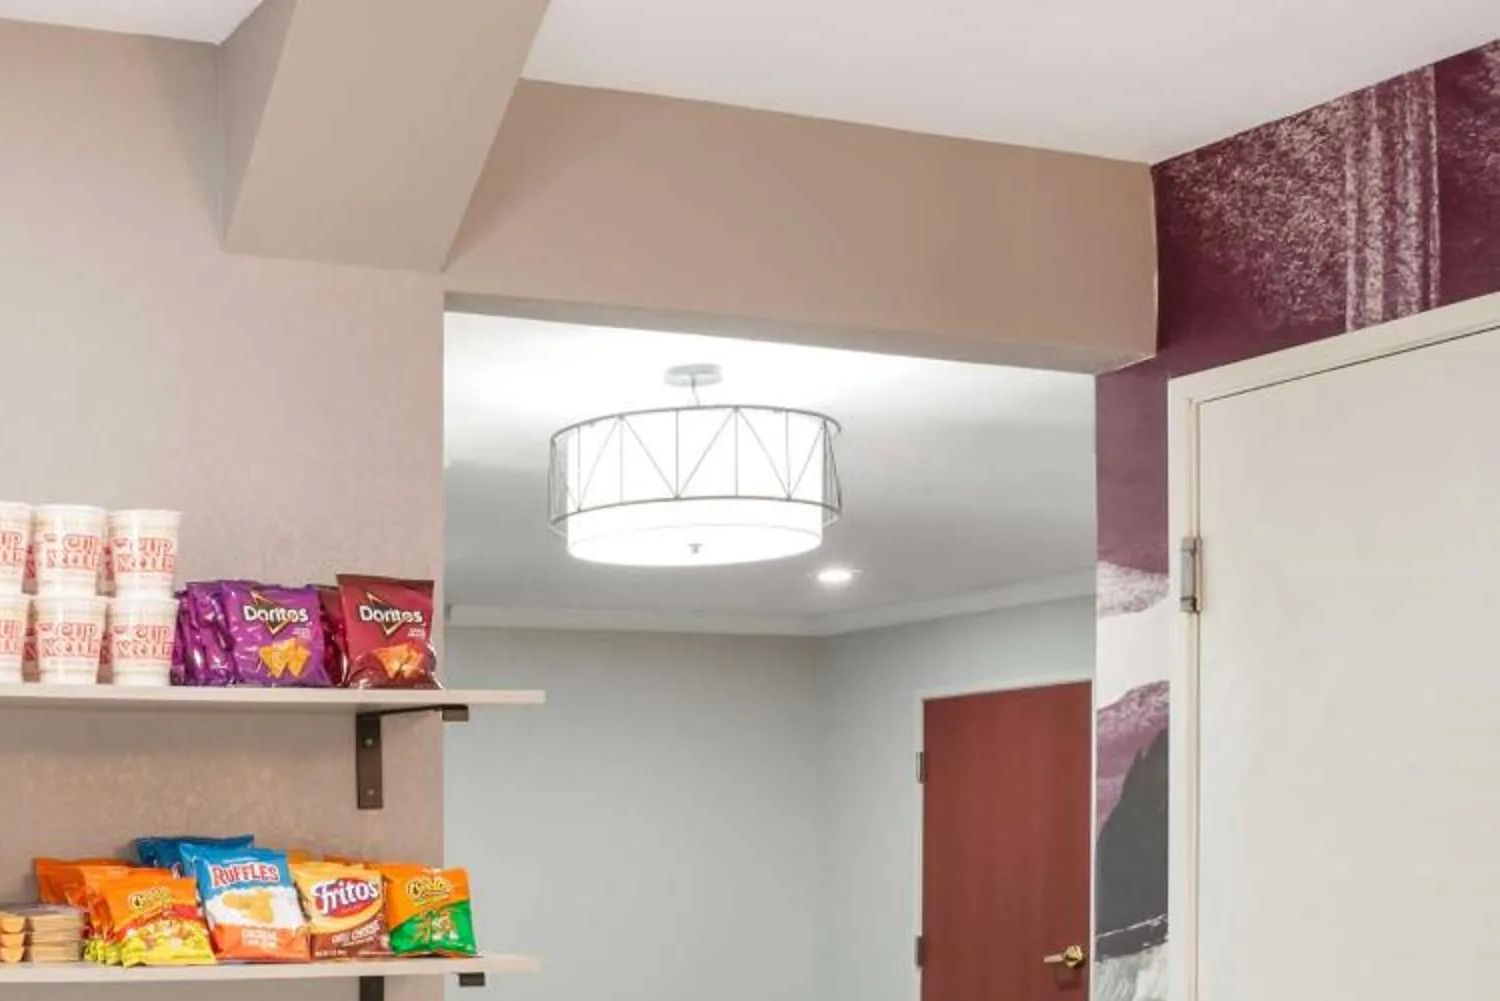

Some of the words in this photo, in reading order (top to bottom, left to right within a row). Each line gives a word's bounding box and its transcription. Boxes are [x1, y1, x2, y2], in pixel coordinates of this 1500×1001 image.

[243, 605, 309, 623] Doritos
[359, 605, 423, 623] Doritos
[211, 863, 278, 887] RUFFLES
[312, 880, 381, 915] Fritos
